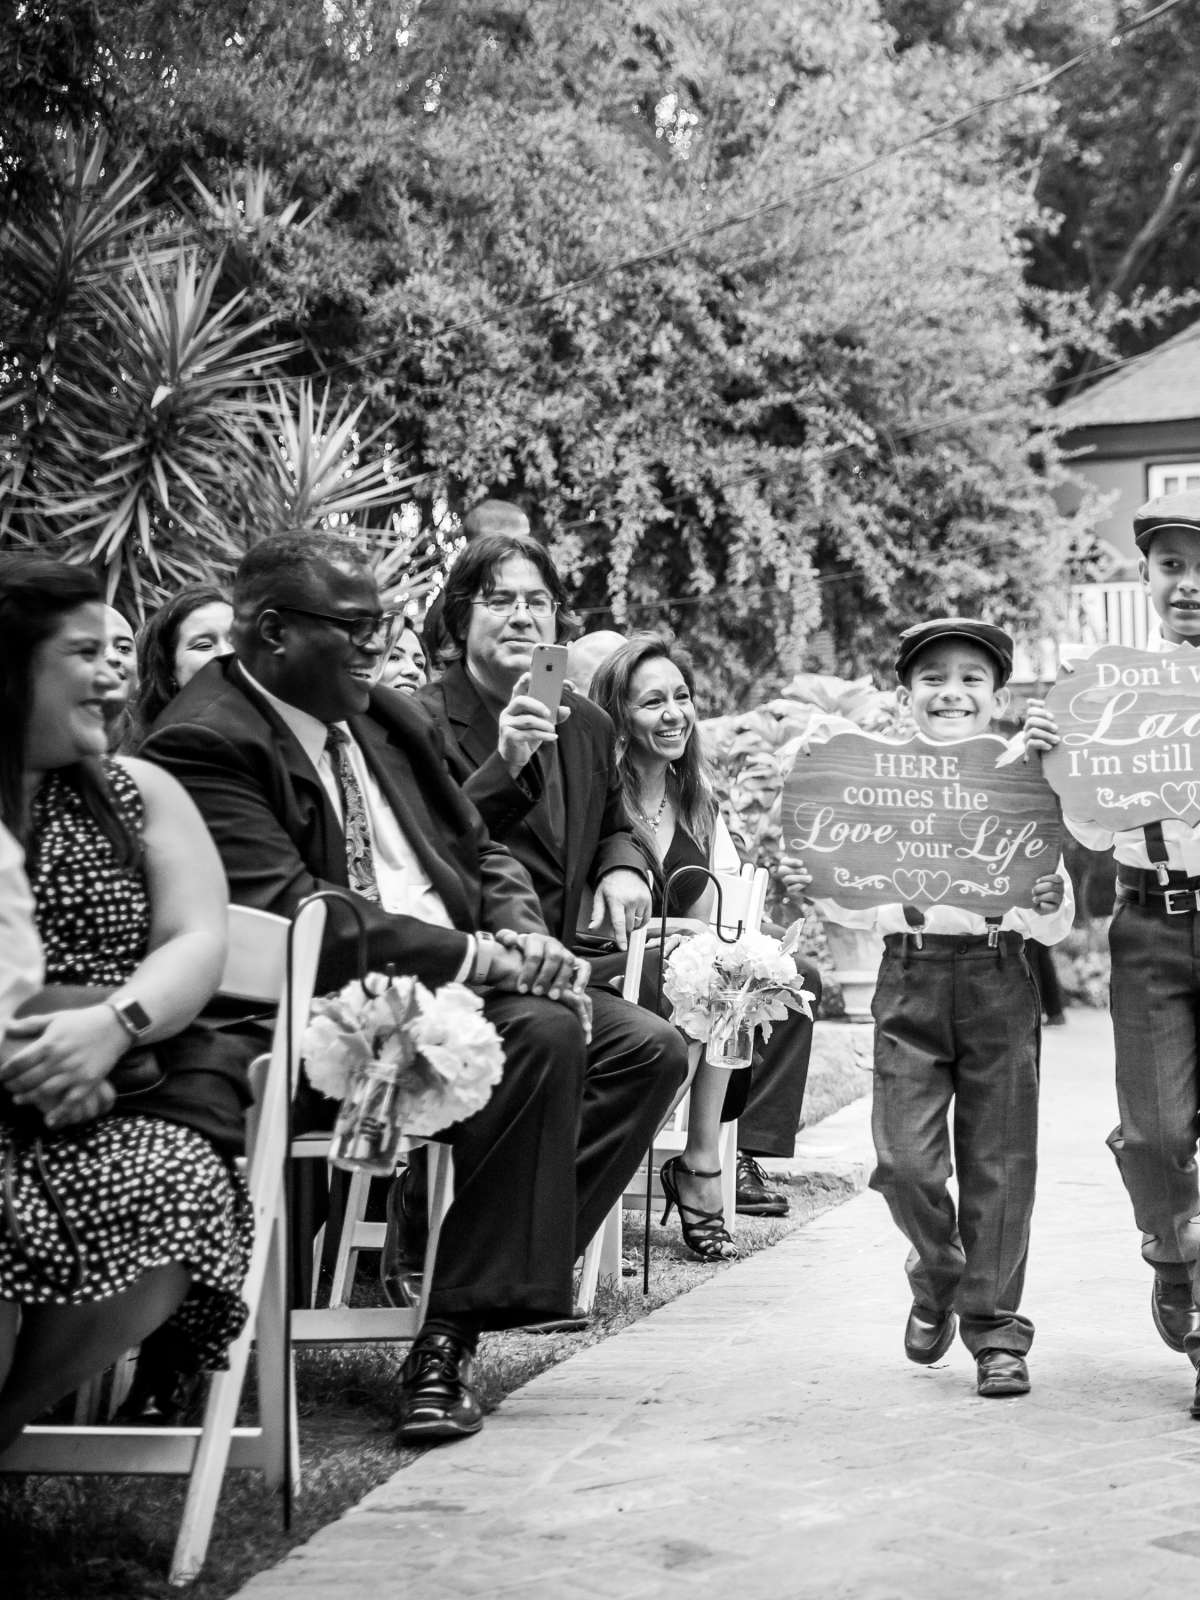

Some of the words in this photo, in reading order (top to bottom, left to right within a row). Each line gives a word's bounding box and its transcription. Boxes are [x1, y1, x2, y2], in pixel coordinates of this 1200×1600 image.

[1095, 659, 1181, 688] Don't
[874, 753, 960, 780] HERE
[1067, 748, 1122, 777] I'm
[1132, 743, 1194, 774] still
[843, 784, 935, 808] comes
[941, 783, 989, 811] the
[790, 802, 898, 853] Love
[910, 813, 937, 836] of
[896, 840, 953, 863] your
[954, 810, 1049, 876] Life
